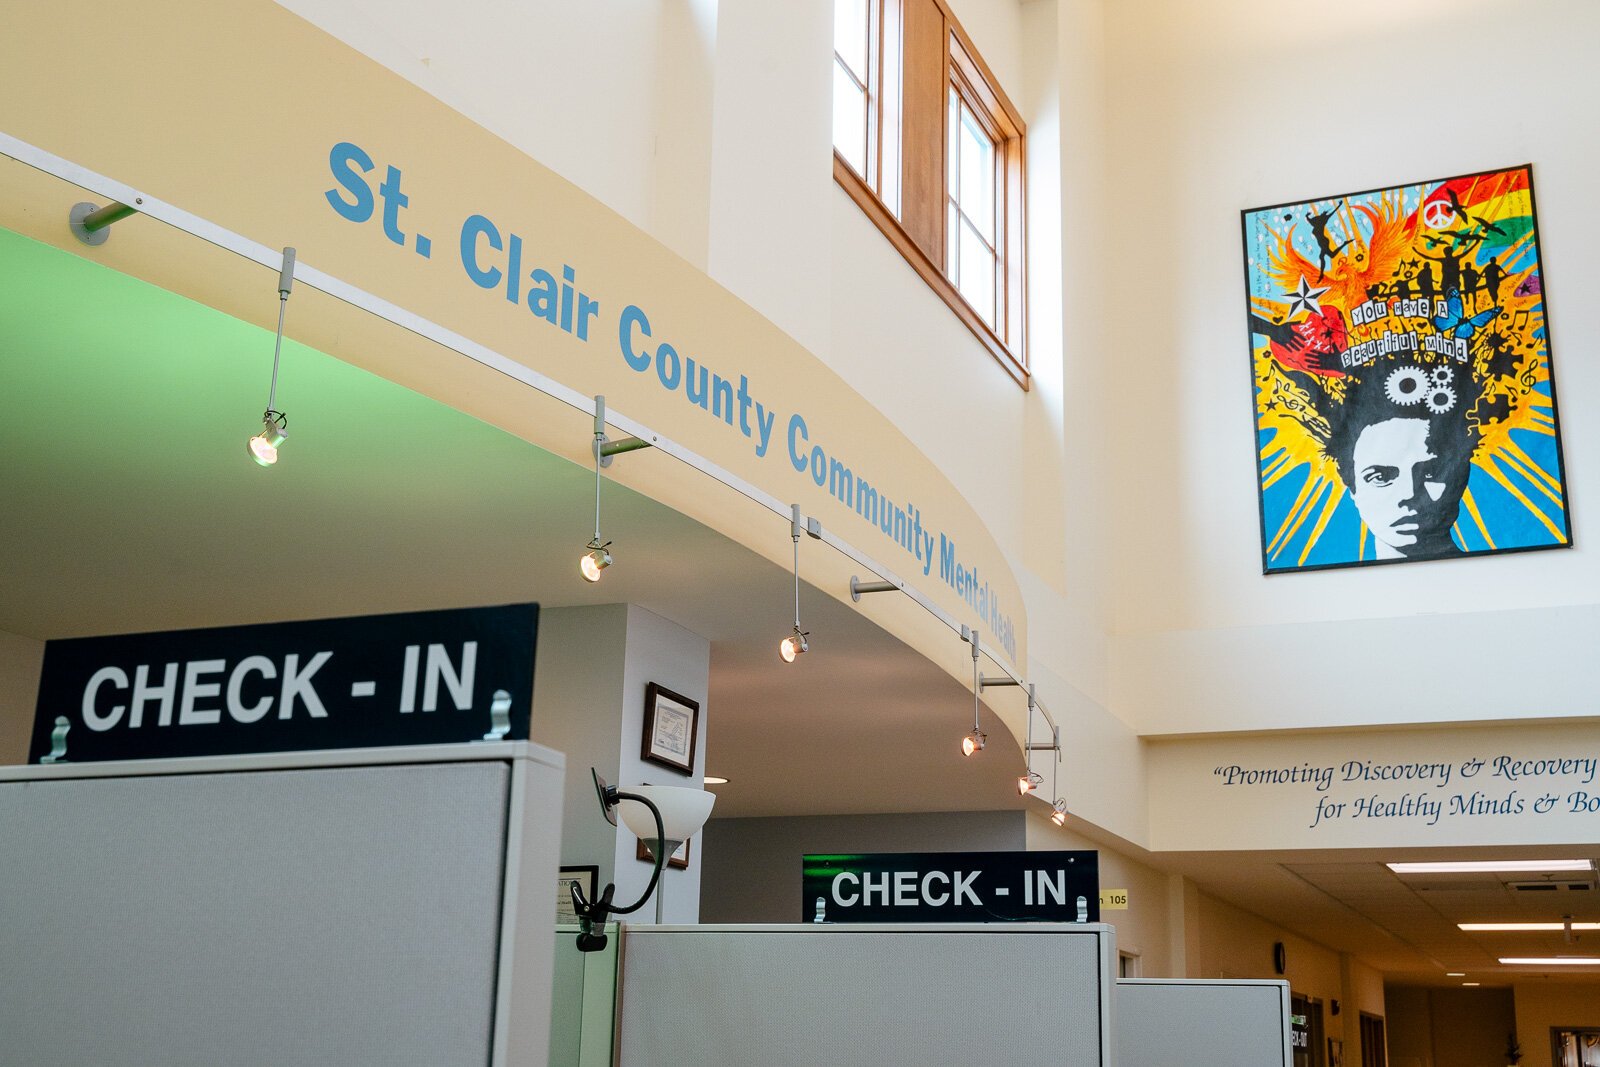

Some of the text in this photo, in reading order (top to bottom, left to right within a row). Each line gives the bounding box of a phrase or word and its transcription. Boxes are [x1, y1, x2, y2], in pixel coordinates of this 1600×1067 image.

[1438, 301, 1448, 318] A
[325, 142, 1017, 666] St. Clair County Community Mental Health
[82, 641, 478, 732] CHECK - IN
[1341, 760, 1452, 788] Discovery
[1460, 758, 1486, 778] &
[1493, 755, 1598, 784] Recovery
[1310, 794, 1347, 828] for
[1352, 793, 1442, 826] Healthy
[1450, 791, 1525, 817] Minds
[1534, 793, 1560, 814] &
[831, 869, 1066, 907] CHECK - IN
[1110, 895, 1127, 905] 105
